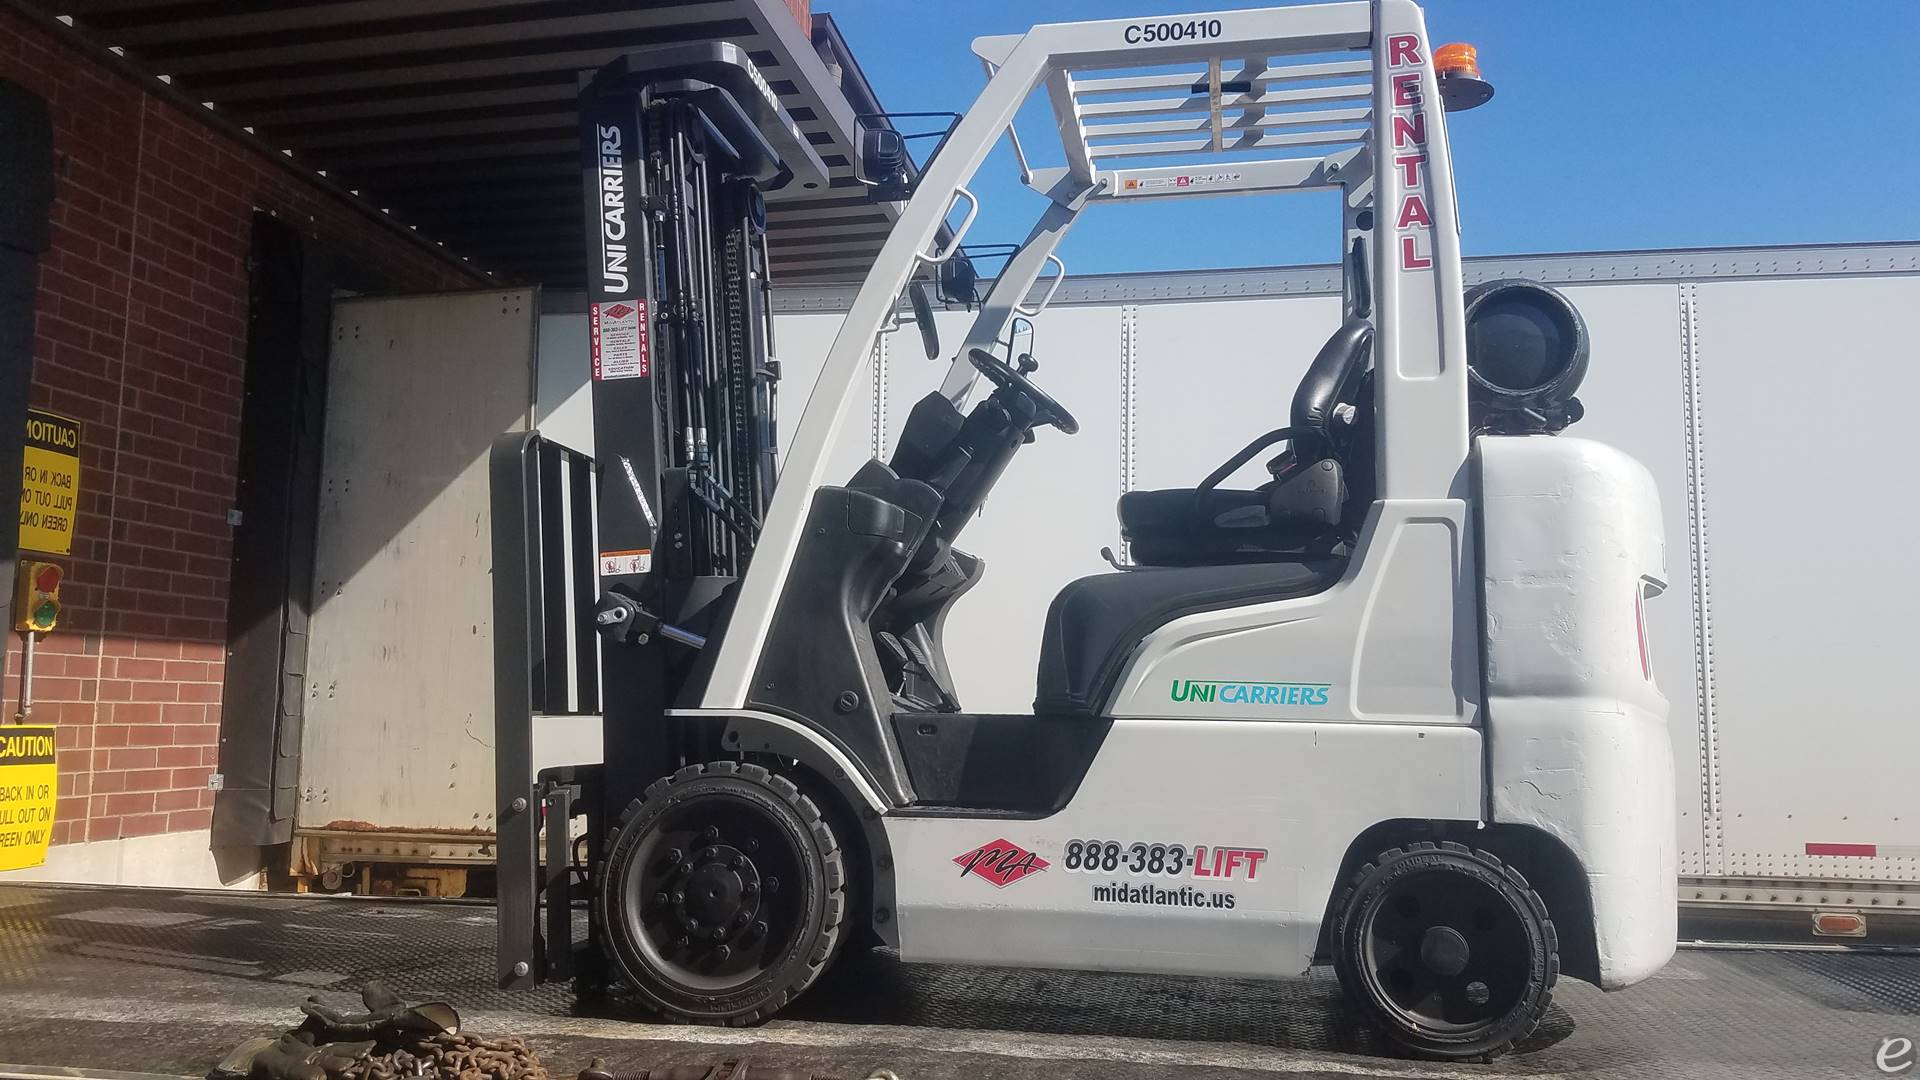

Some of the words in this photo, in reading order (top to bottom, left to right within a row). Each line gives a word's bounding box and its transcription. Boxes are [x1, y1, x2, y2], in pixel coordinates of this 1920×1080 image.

[1124, 20, 1222, 44] C500410
[1387, 35, 1432, 269] RENTAL
[592, 306, 600, 377] SERVICE
[639, 303, 648, 373] RENTALS
[1171, 680, 1331, 705] UNICARRIERS
[0, 735, 53, 757] CAUTION
[0, 785, 22, 801] BACK
[26, 785, 34, 800] IN
[37, 784, 49, 799] OR
[0, 808, 14, 824] ULL
[18, 807, 36, 824] OUT
[38, 806, 51, 820] ON
[0, 831, 22, 847] REEN
[25, 828, 45, 845] ONLY
[1093, 882, 1236, 910] midatlantic.us
